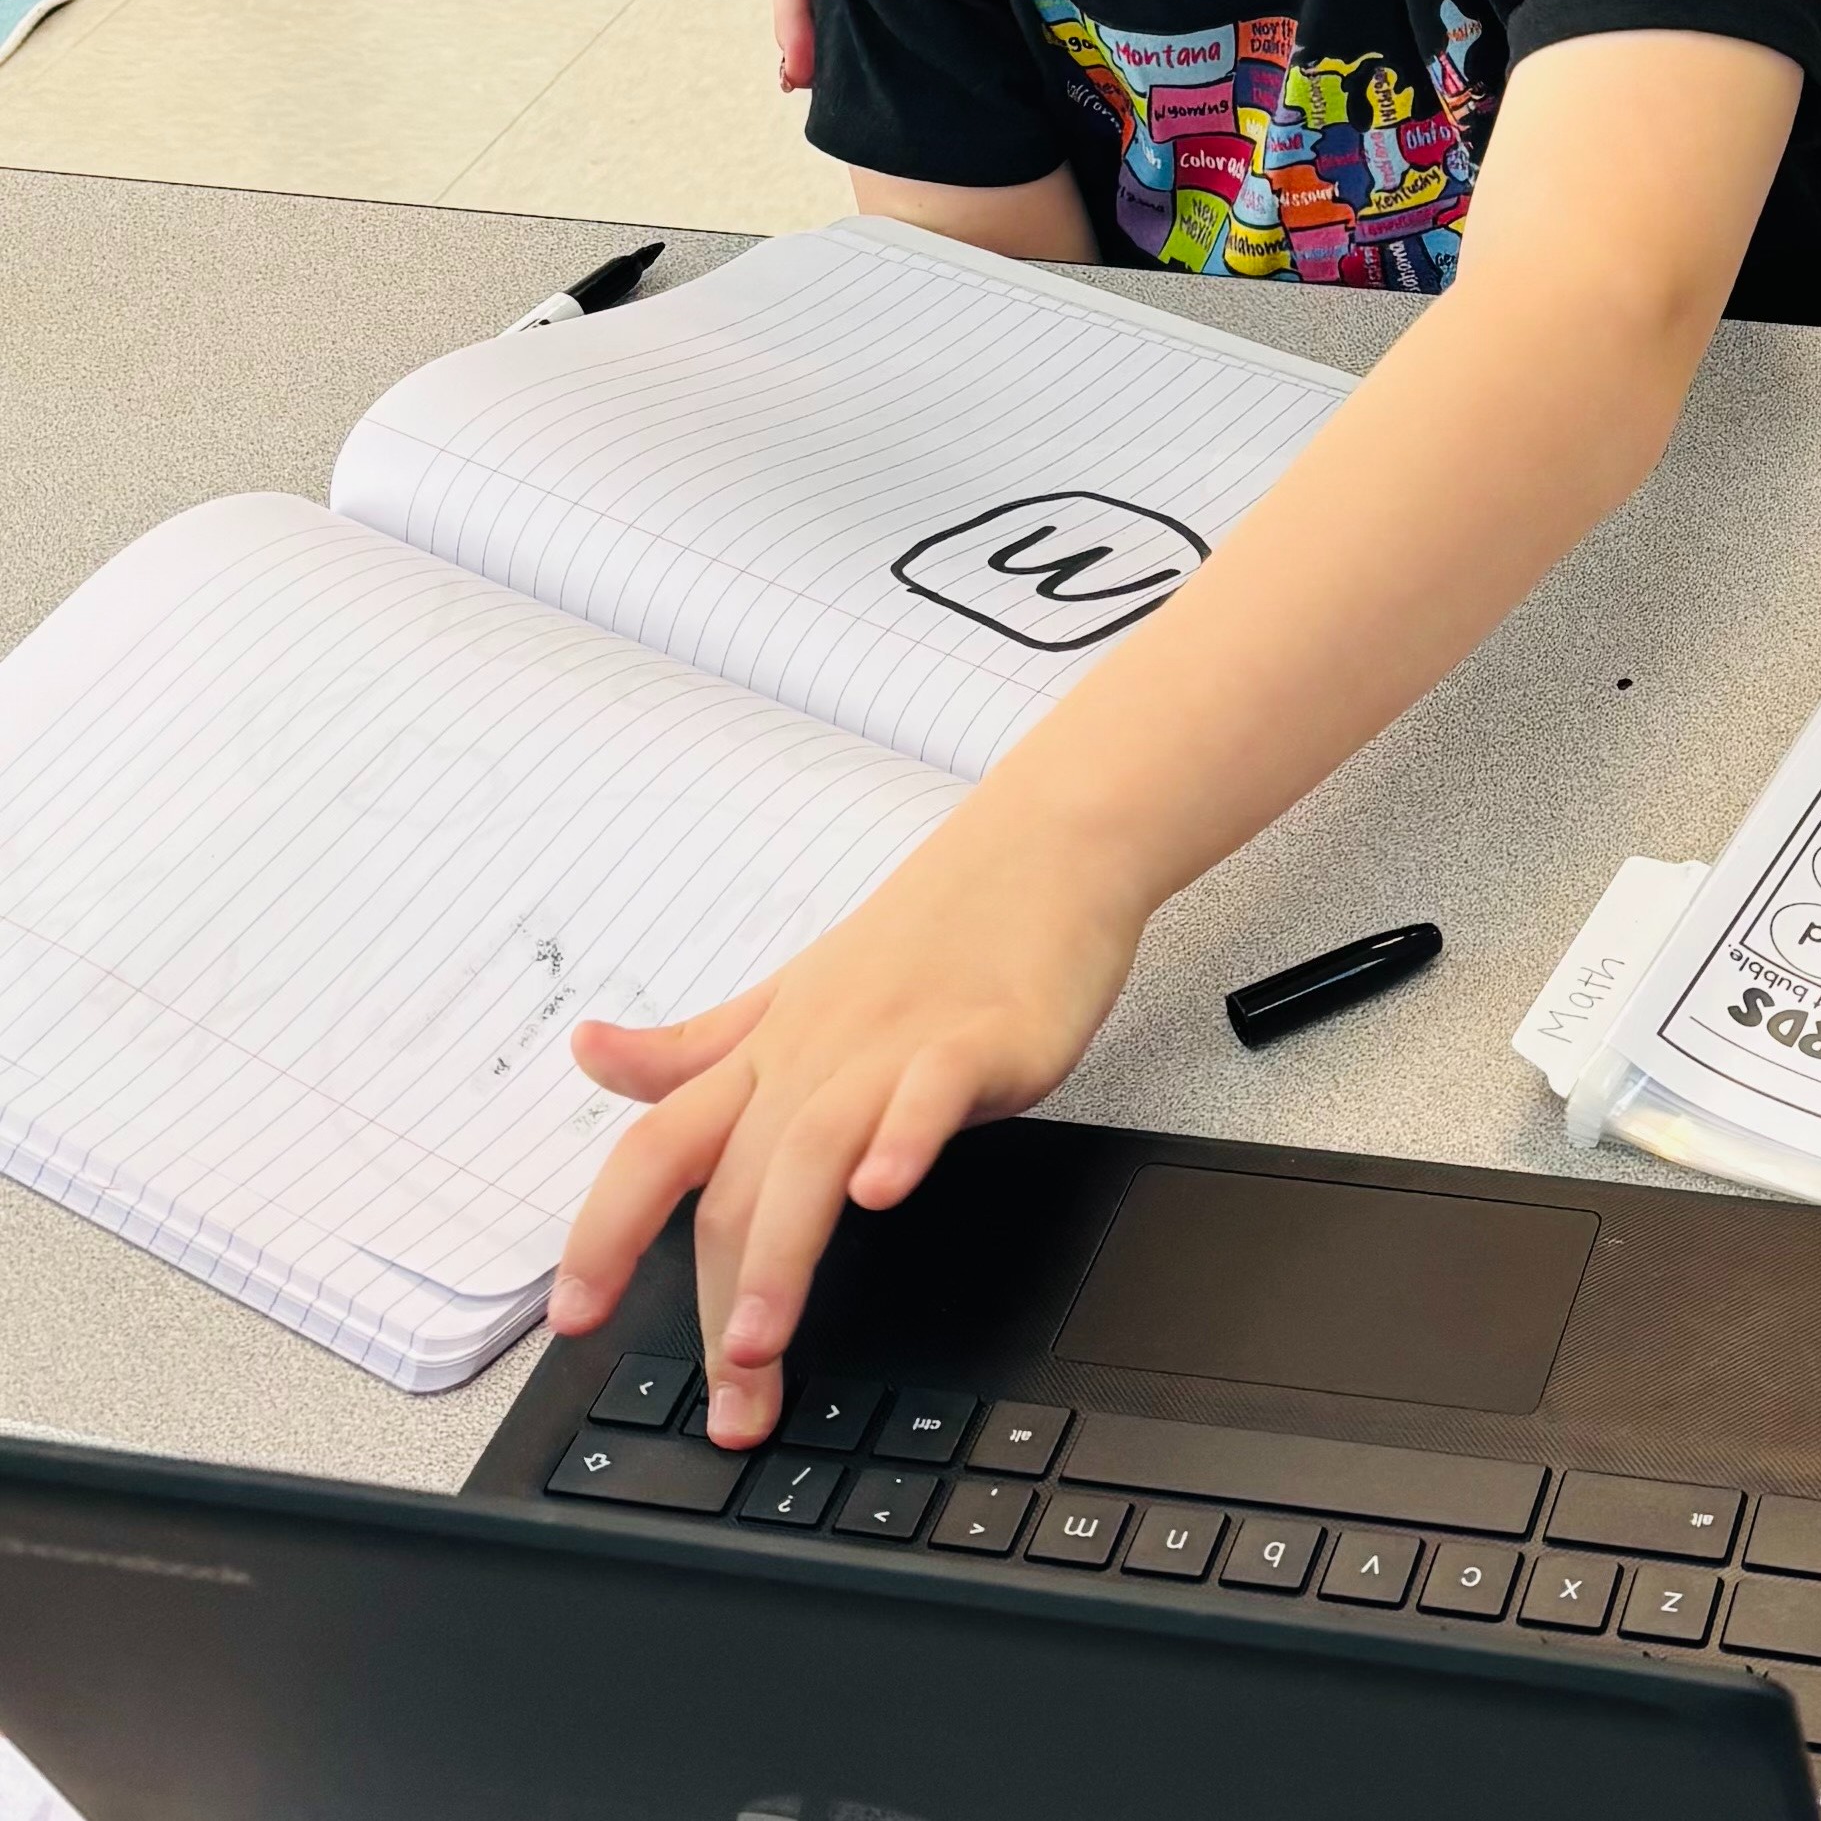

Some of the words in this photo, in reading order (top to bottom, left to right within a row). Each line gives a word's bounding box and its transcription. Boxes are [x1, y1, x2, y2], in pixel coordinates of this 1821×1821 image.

[1115, 39, 1222, 71] Montana
[1153, 98, 1230, 123] Wyoming
[1179, 149, 1247, 183] Colorad
[1274, 180, 1340, 210] issouri
[1726, 943, 1804, 1003] bubble.
[1537, 956, 1626, 1046] Math
[913, 1418, 941, 1430] ctrl
[1010, 1430, 1032, 1442] alt
[1064, 1517, 1098, 1537] m
[1691, 1513, 1713, 1527] alt
[1167, 1530, 1188, 1548] n
[1264, 1542, 1285, 1567] b
